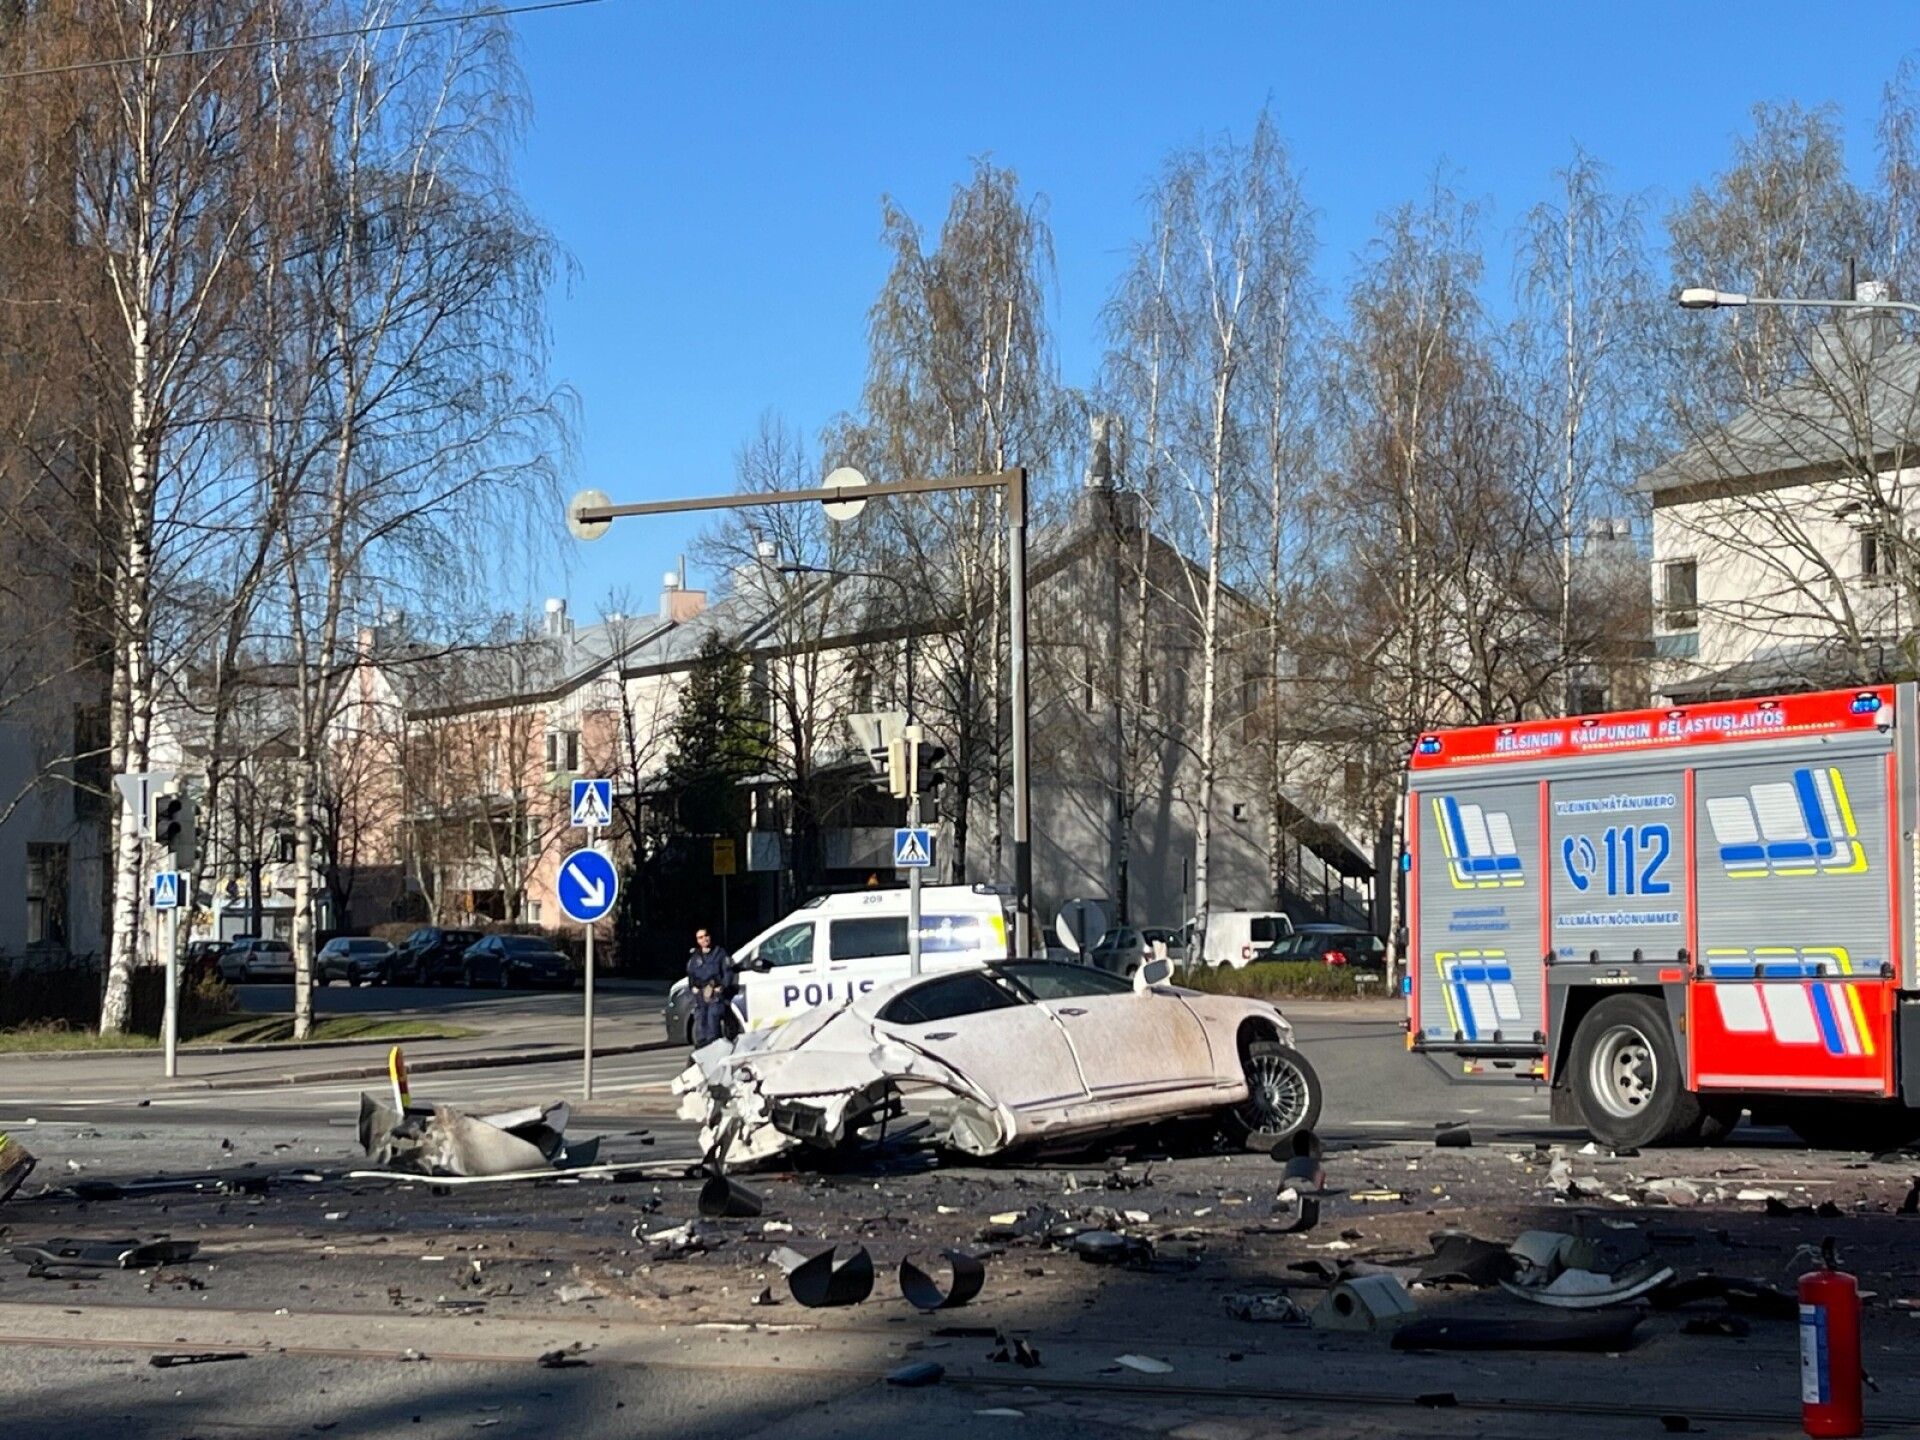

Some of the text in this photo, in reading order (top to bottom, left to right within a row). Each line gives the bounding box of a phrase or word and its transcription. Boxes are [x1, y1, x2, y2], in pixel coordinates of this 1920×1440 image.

[1495, 711, 1784, 751] HELSINGIN KAUPUNGIN PELASTUSLAITOS
[1557, 795, 1675, 814] YLEINEN HÄTÄNUMERO
[1604, 825, 1670, 895] 112
